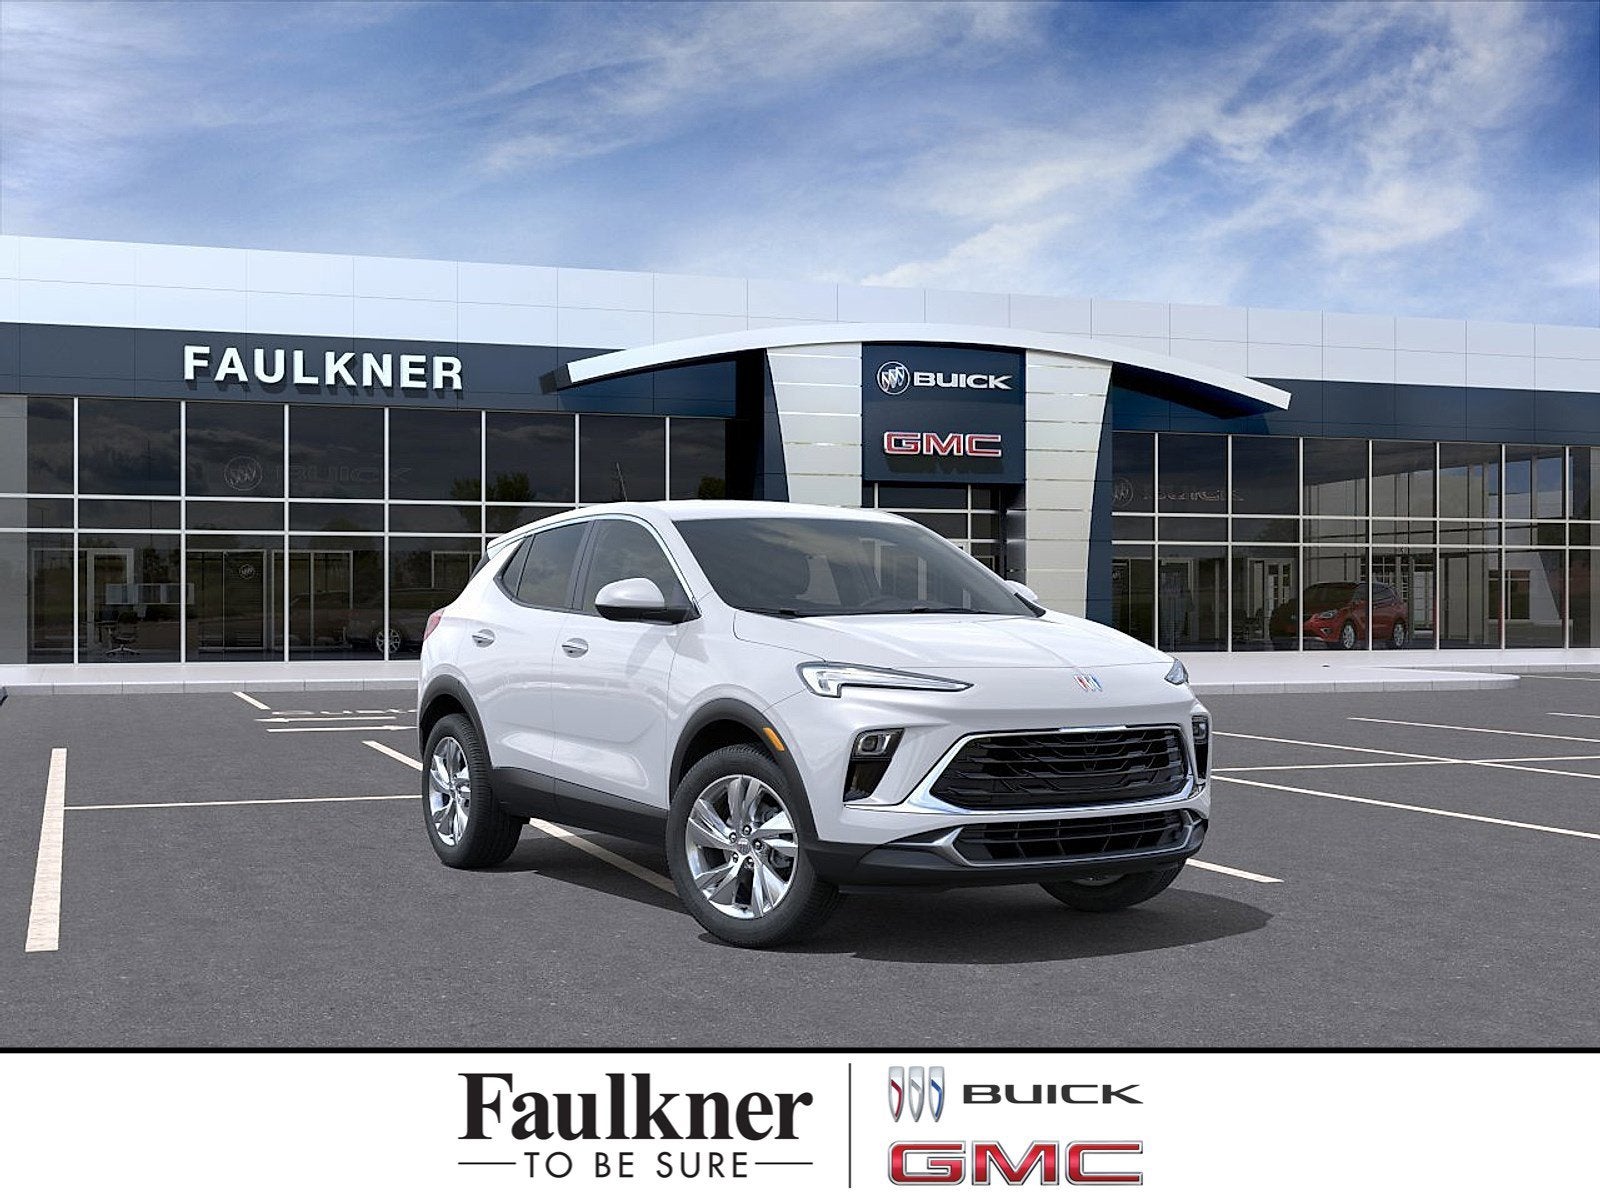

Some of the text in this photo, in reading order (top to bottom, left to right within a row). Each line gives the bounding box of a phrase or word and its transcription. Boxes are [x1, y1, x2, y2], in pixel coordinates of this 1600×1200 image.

[183, 344, 464, 391] FAULKNER
[913, 371, 1013, 390] BUICK
[883, 431, 1002, 458] GMC
